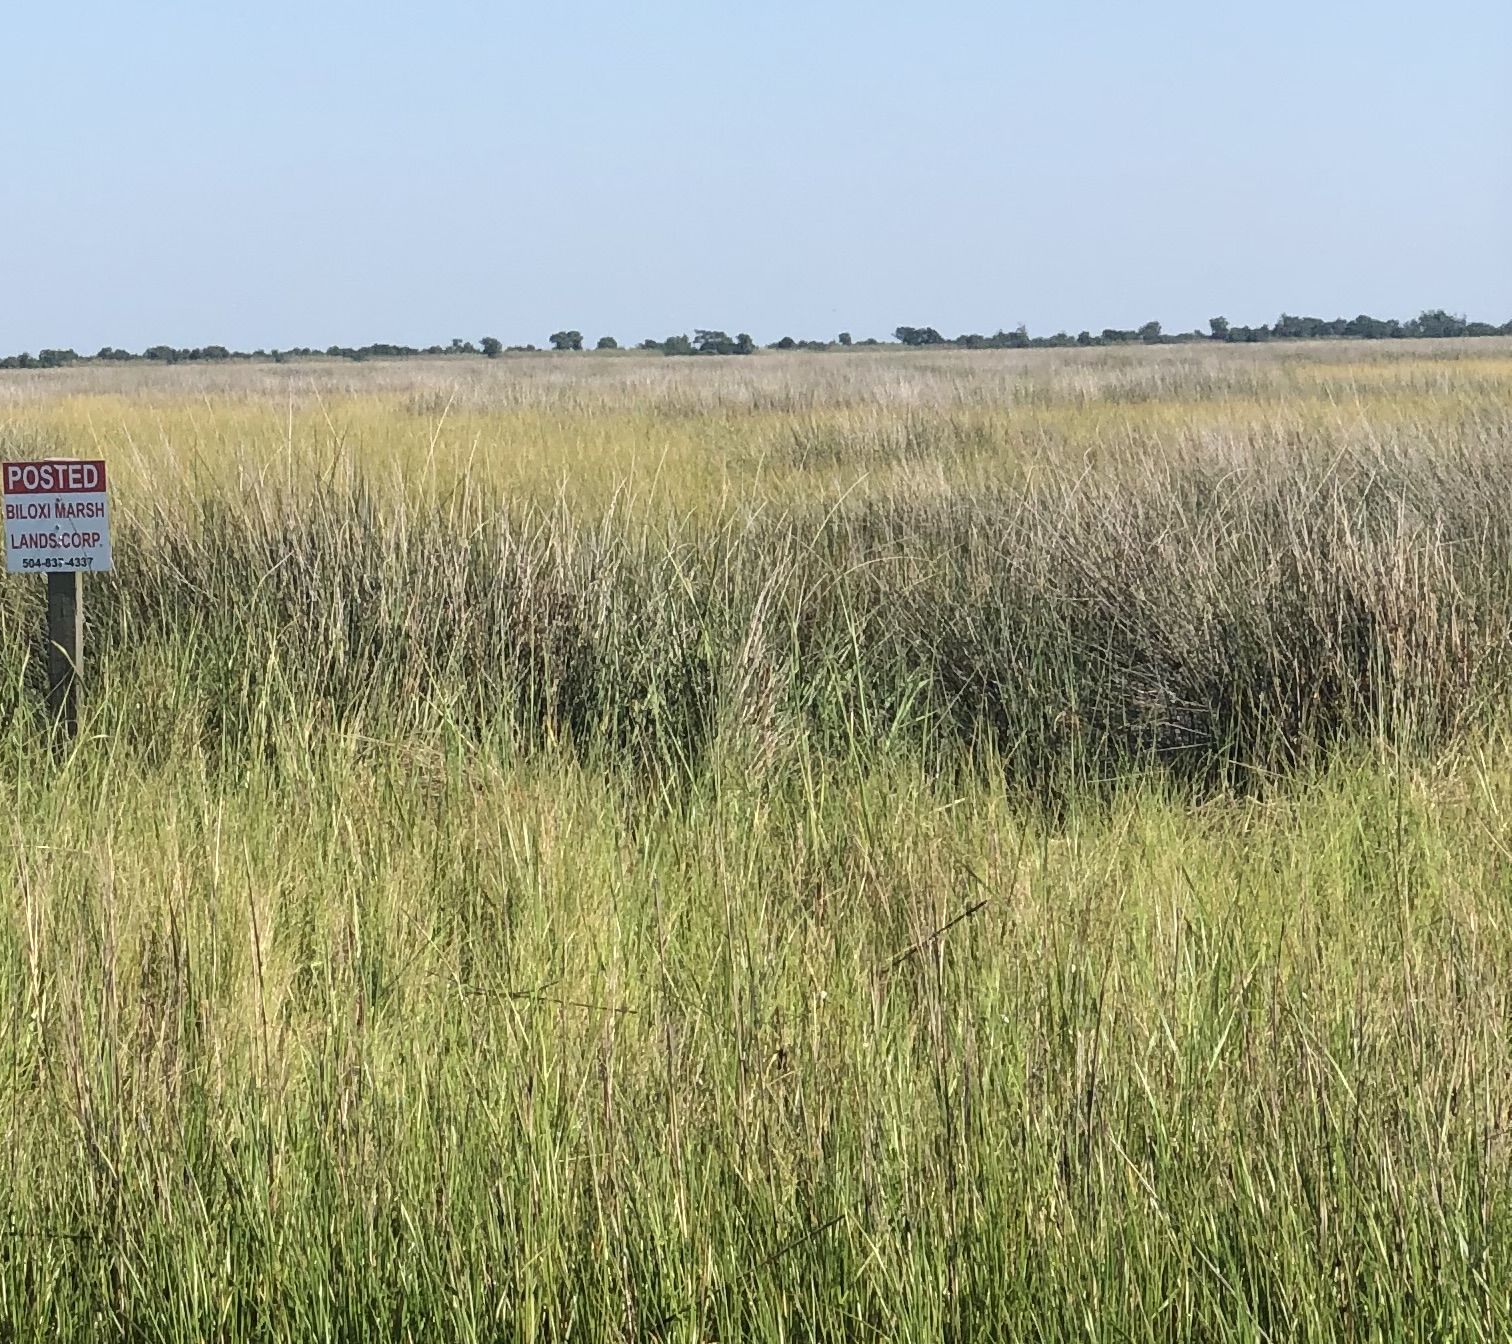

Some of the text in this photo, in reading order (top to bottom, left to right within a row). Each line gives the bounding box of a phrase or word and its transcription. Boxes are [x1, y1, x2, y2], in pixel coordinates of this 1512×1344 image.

[8, 464, 98, 490] POSTED
[6, 502, 105, 519] BILOXI MARSH
[11, 533, 58, 549] LANDS
